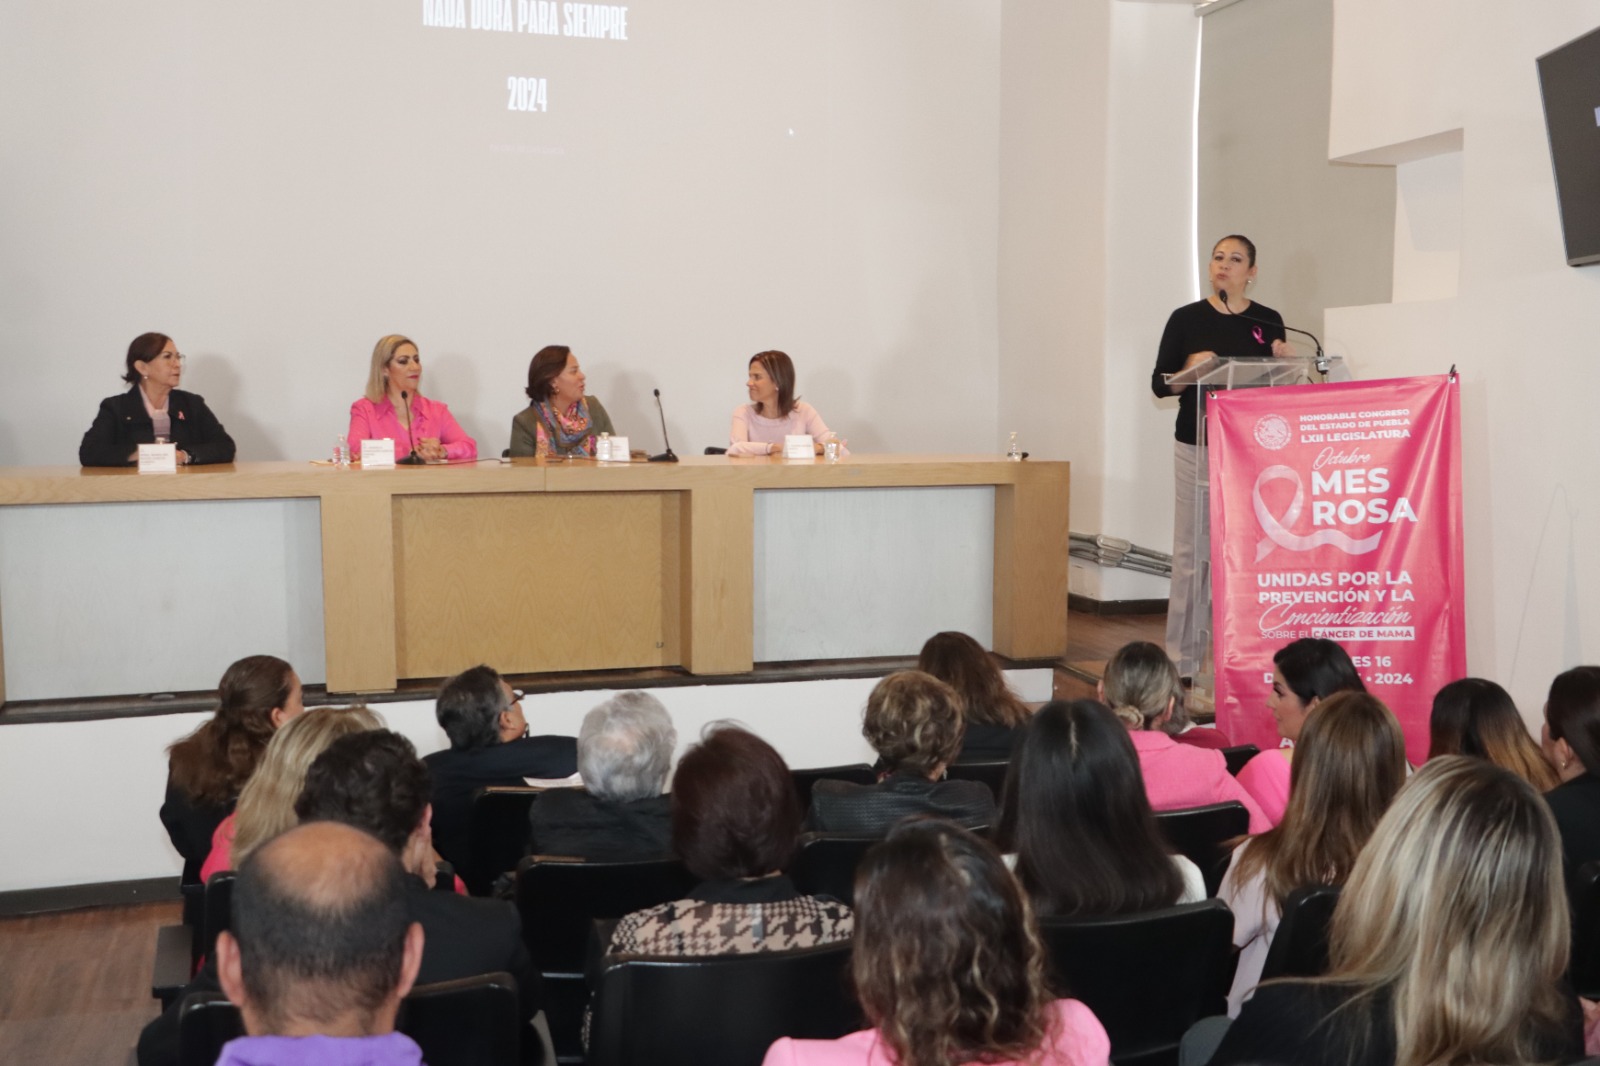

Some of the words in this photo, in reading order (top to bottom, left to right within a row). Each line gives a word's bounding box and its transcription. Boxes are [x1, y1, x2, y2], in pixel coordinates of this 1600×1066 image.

[423, 0, 466, 28] NADA
[471, 0, 513, 32] DURA
[518, 0, 559, 35] PARA
[563, 2, 628, 40] SIEMPRE
[507, 76, 547, 112] 2024
[1300, 412, 1355, 422] HONORABLE
[1358, 409, 1410, 419] CONGRESO
[1300, 423, 1317, 431] DEL
[1320, 421, 1355, 430] ESTADO
[1358, 420, 1371, 428] DE
[1373, 418, 1410, 426] PUEBLA
[1301, 433, 1324, 443] LXII
[1327, 429, 1410, 442] LEGISLATURA
[1313, 447, 1371, 470] Octubre
[1312, 468, 1389, 495] MES
[1312, 497, 1418, 526] ROSA
[1257, 572, 1333, 587] UNIDAS
[1338, 571, 1379, 586] POR
[1386, 571, 1412, 584] LA
[1259, 588, 1370, 603] PREVENCIÓN
[1375, 590, 1386, 602] Y
[1391, 589, 1414, 601] LA
[1261, 630, 1296, 639] SOBRE
[1299, 630, 1309, 638] EL
[1314, 629, 1355, 639] CÁNCER
[1360, 630, 1373, 638] DE
[1377, 630, 1412, 638] MAMA
[1376, 656, 1391, 666] 16
[1375, 673, 1413, 684] 2024
